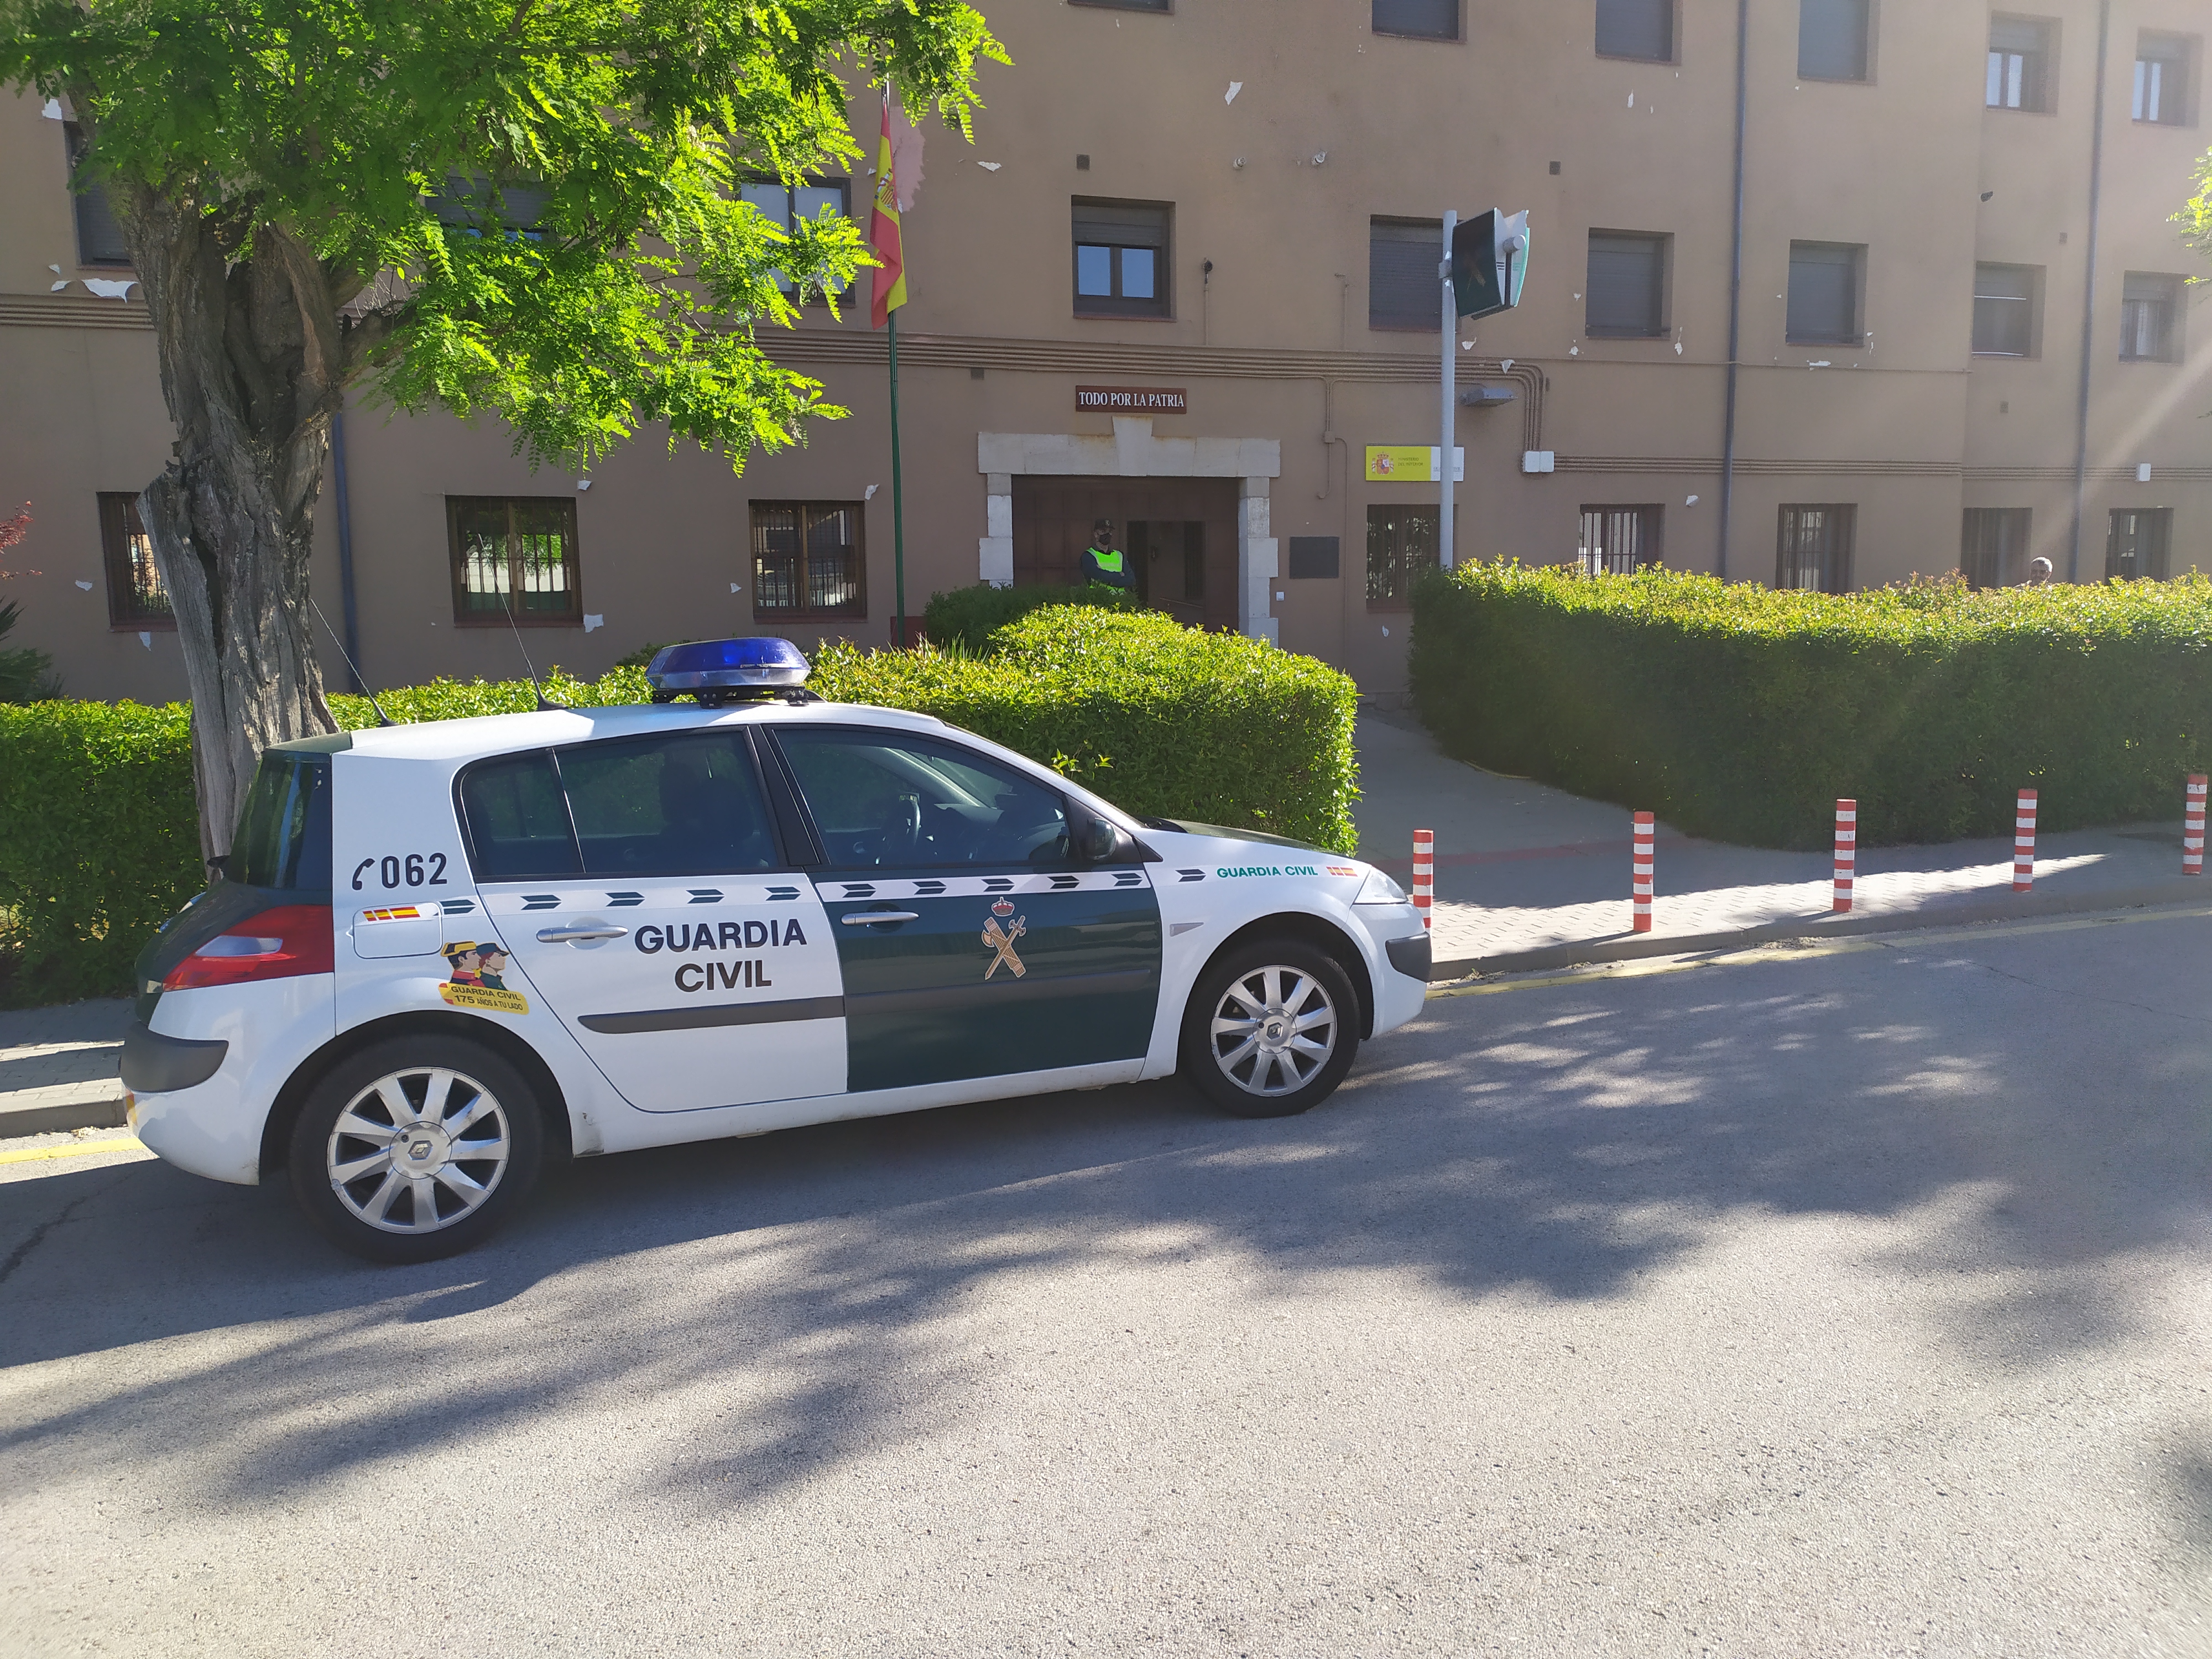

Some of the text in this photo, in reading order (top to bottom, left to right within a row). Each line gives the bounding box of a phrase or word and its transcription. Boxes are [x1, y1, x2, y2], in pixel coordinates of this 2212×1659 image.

[1079, 392, 1184, 407] TODO POR LA PATRIA
[382, 853, 447, 889] 062
[1217, 866, 1318, 878] GUARDIA CIVIL
[635, 919, 807, 954] GUARDIA
[675, 959, 772, 993] CIVIL
[451, 986, 521, 1000] GUARDIA CIVIL
[455, 995, 475, 1004] 175
[477, 997, 493, 1006] AÑOS
[508, 1002, 523, 1011] LADO
